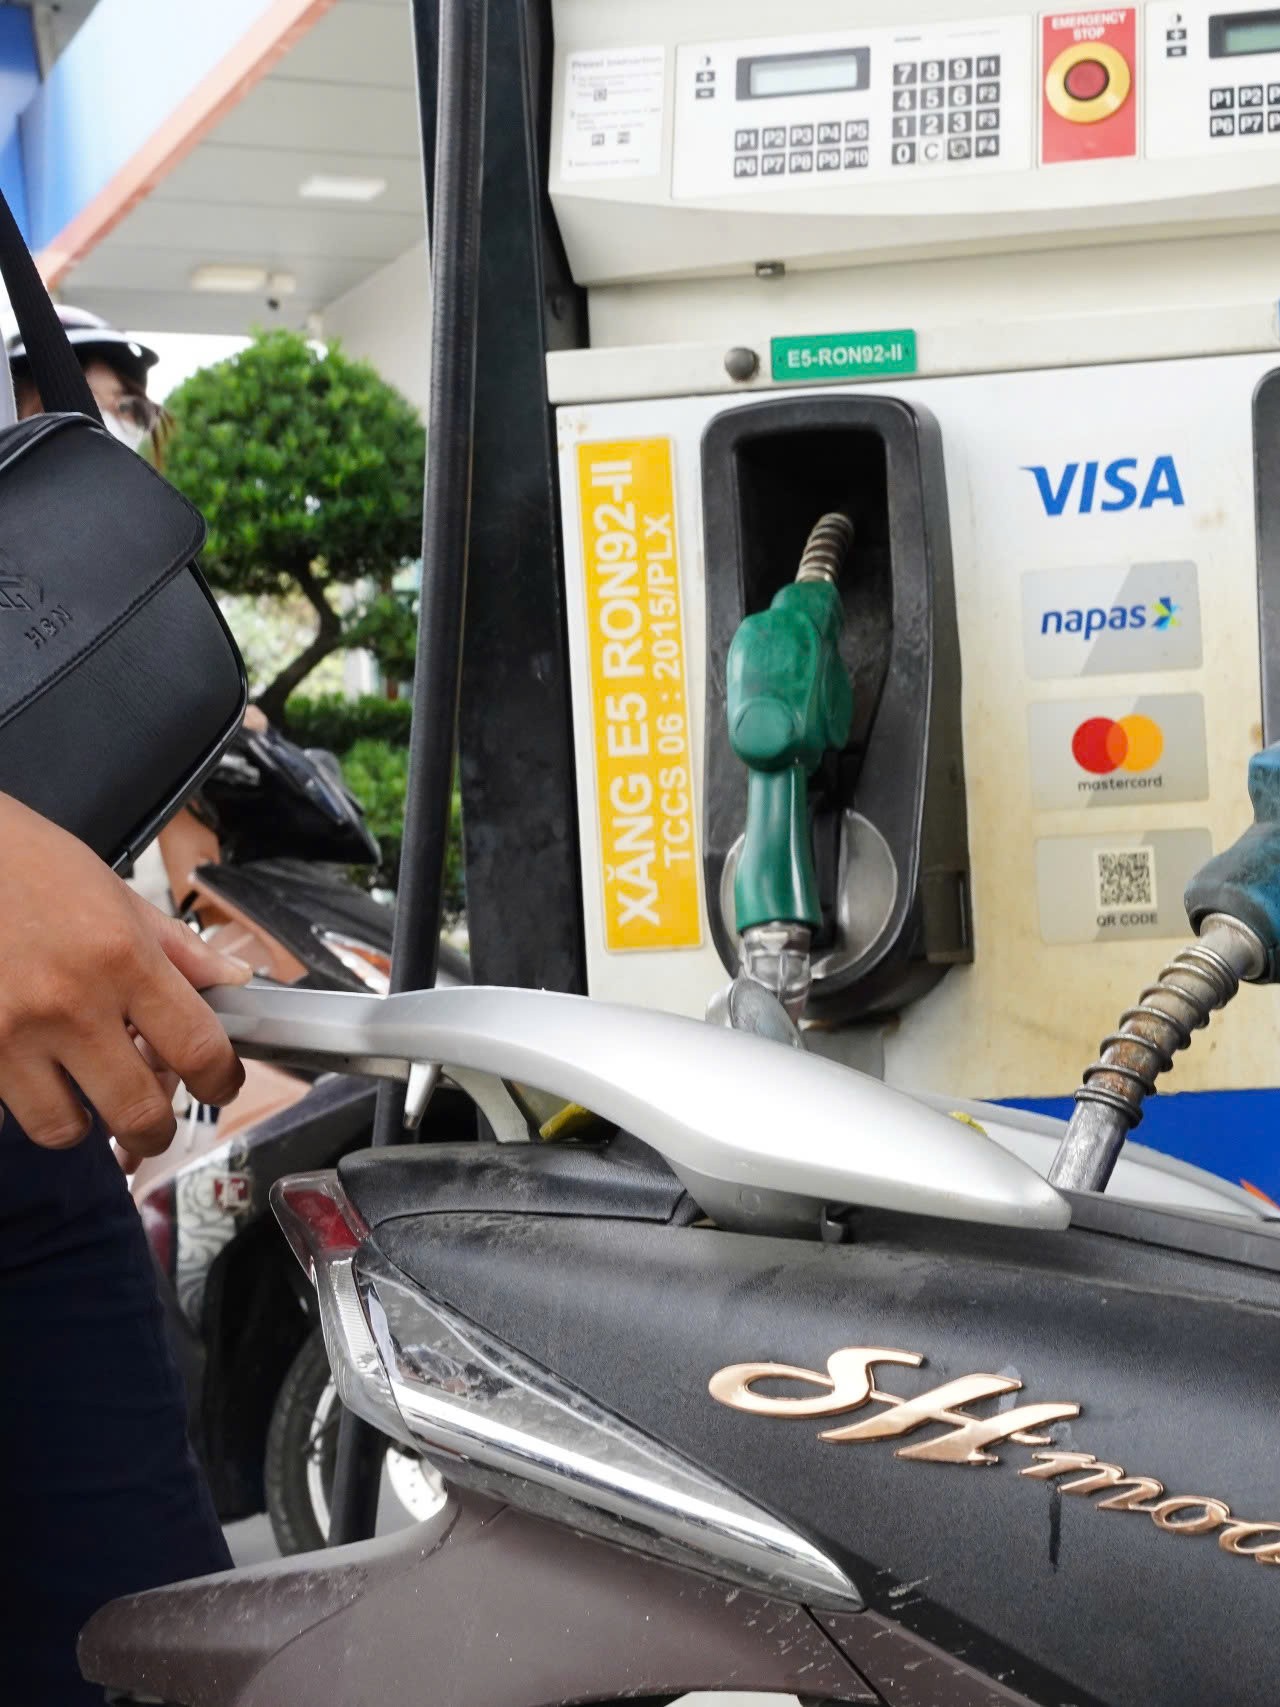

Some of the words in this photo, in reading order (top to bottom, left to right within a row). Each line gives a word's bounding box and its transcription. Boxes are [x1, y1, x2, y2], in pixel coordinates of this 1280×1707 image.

[1052, 11, 1126, 30] EMERGENCY
[1073, 27, 1105, 41] STOP
[900, 66, 911, 83] 7
[926, 63, 938, 80] 8
[954, 60, 966, 77] 9
[980, 61, 995, 74] F1
[899, 92, 910, 109] 4
[926, 90, 938, 107] 5
[954, 87, 966, 104] 6
[979, 86, 996, 100] F2
[1212, 92, 1231, 107] P1
[1240, 89, 1260, 104] P2
[737, 133, 755, 147] P1
[764, 131, 783, 146] P2
[792, 128, 811, 144] P3
[820, 126, 839, 141] P4
[847, 123, 867, 138] P5
[900, 119, 908, 135] 1
[926, 117, 938, 133] 2
[953, 114, 966, 131] 3
[979, 114, 996, 127] F3
[1212, 118, 1232, 133] P6
[1240, 116, 1260, 131] P7
[736, 159, 756, 175] P6
[763, 157, 783, 172] P7
[791, 155, 811, 170] P8
[818, 152, 839, 168] P9
[845, 150, 868, 165] P10
[897, 146, 909, 162] 0
[924, 143, 939, 159] C
[979, 141, 995, 154] F4
[787, 344, 902, 368] E5-RON92-II
[1018, 455, 1185, 516] VISA
[590, 460, 644, 678] RON92-II
[643, 512, 681, 680] 2015/PLX
[1040, 602, 1146, 640] napas
[605, 692, 649, 757] E5
[656, 713, 685, 755] 06
[1078, 776, 1163, 792] mastercard
[659, 766, 690, 868] TCCS
[606, 772, 661, 927] XĂNG
[1096, 915, 1116, 928] QR
[1119, 913, 1158, 925] CODE
